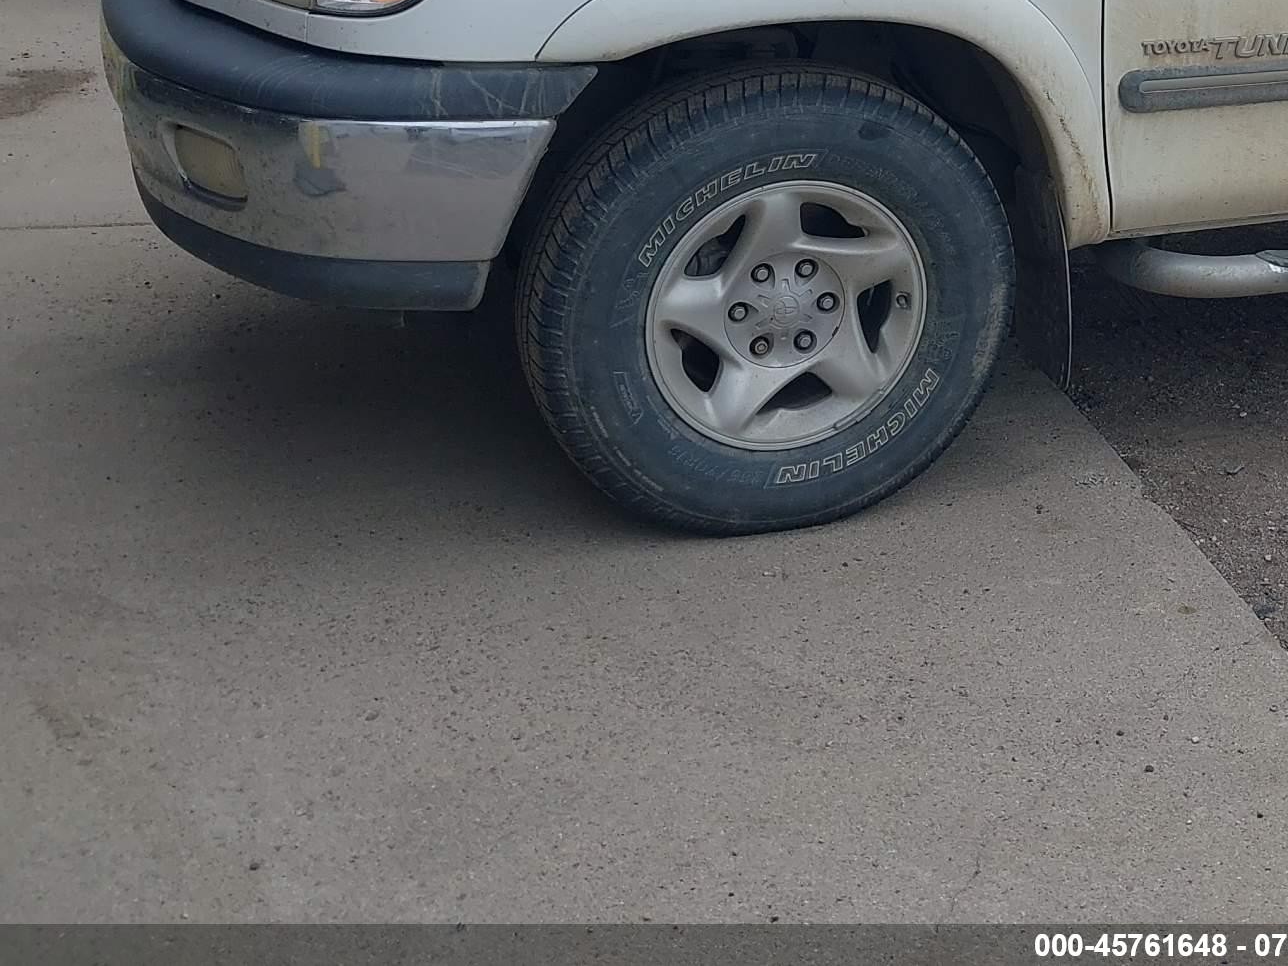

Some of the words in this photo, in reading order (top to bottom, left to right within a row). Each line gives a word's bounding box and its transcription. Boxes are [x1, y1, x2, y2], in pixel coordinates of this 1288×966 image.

[1141, 38, 1211, 56] TOYOTA
[637, 152, 818, 268] MICHELIN
[776, 367, 940, 484] MICHELIN
